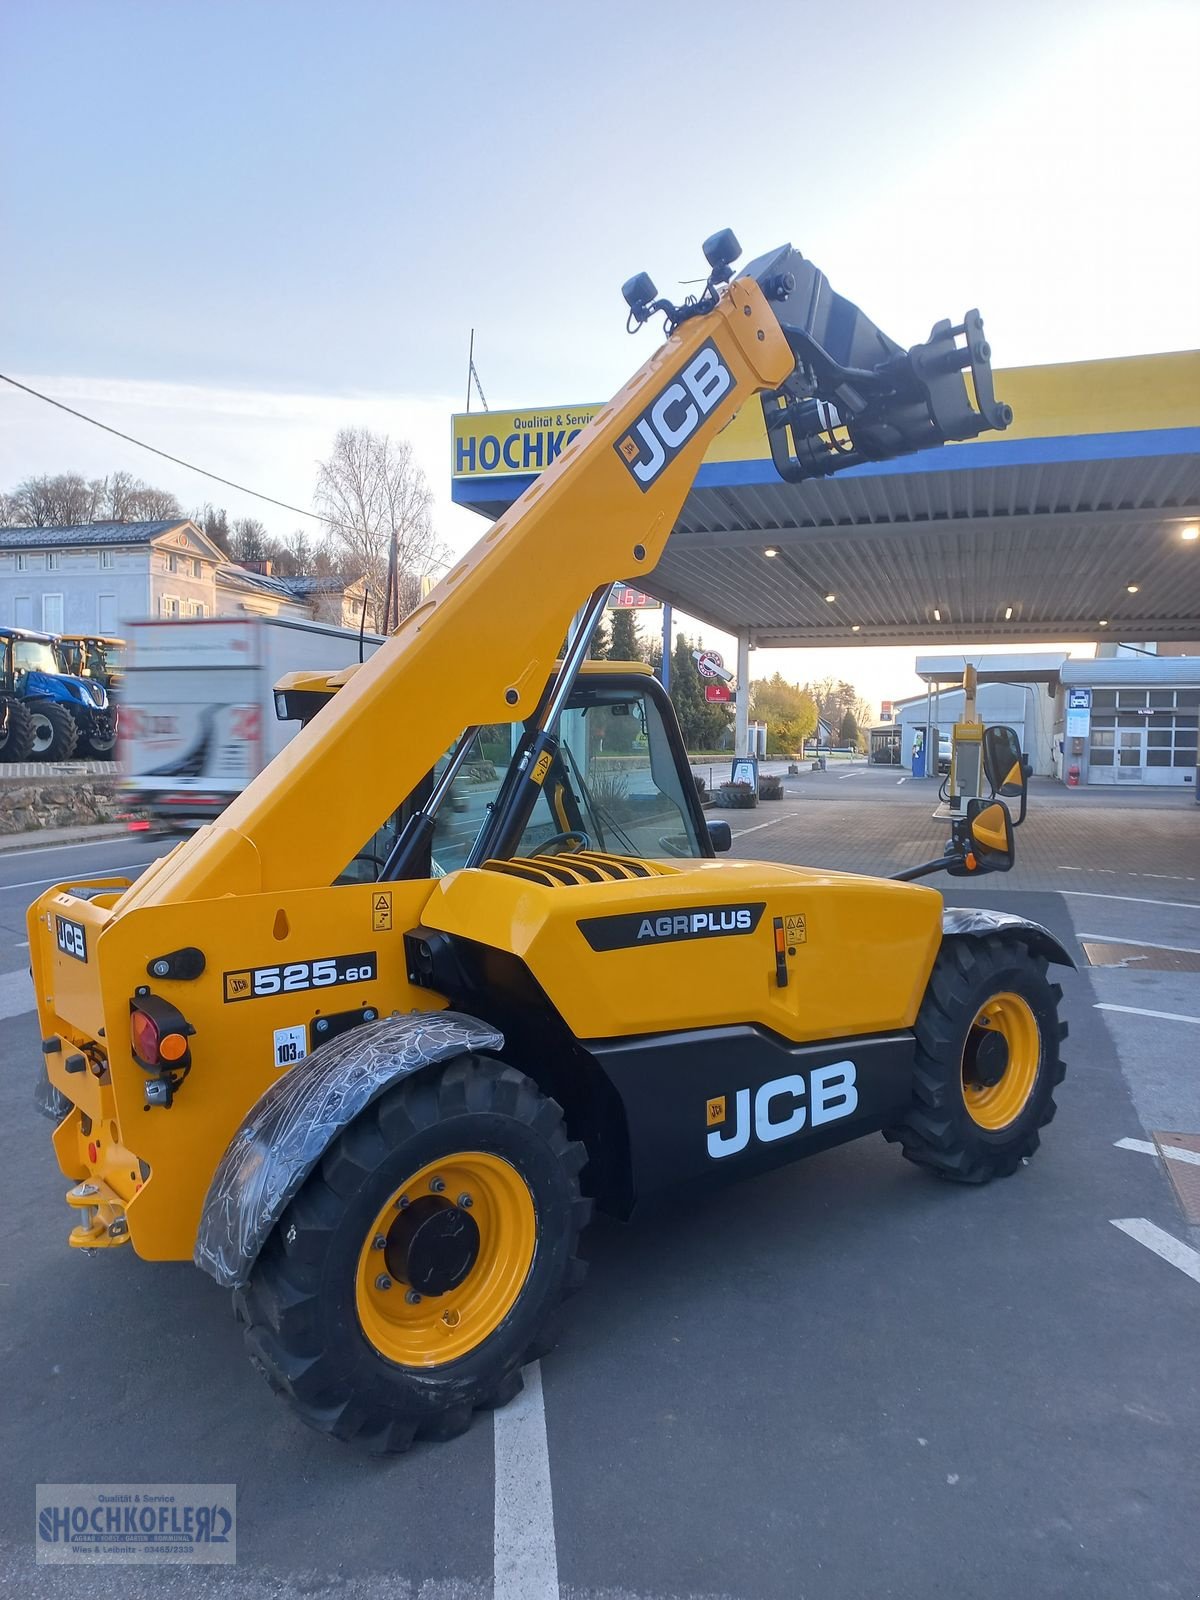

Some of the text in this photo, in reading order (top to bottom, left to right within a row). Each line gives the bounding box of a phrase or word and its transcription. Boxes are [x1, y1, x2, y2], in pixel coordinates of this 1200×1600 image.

[514, 416, 553, 429] Qualität
[556, 415, 563, 426] &
[633, 348, 730, 481] JCB
[58, 920, 85, 958] JCB
[277, 1042, 297, 1064] 103
[707, 1060, 858, 1158] JCB
